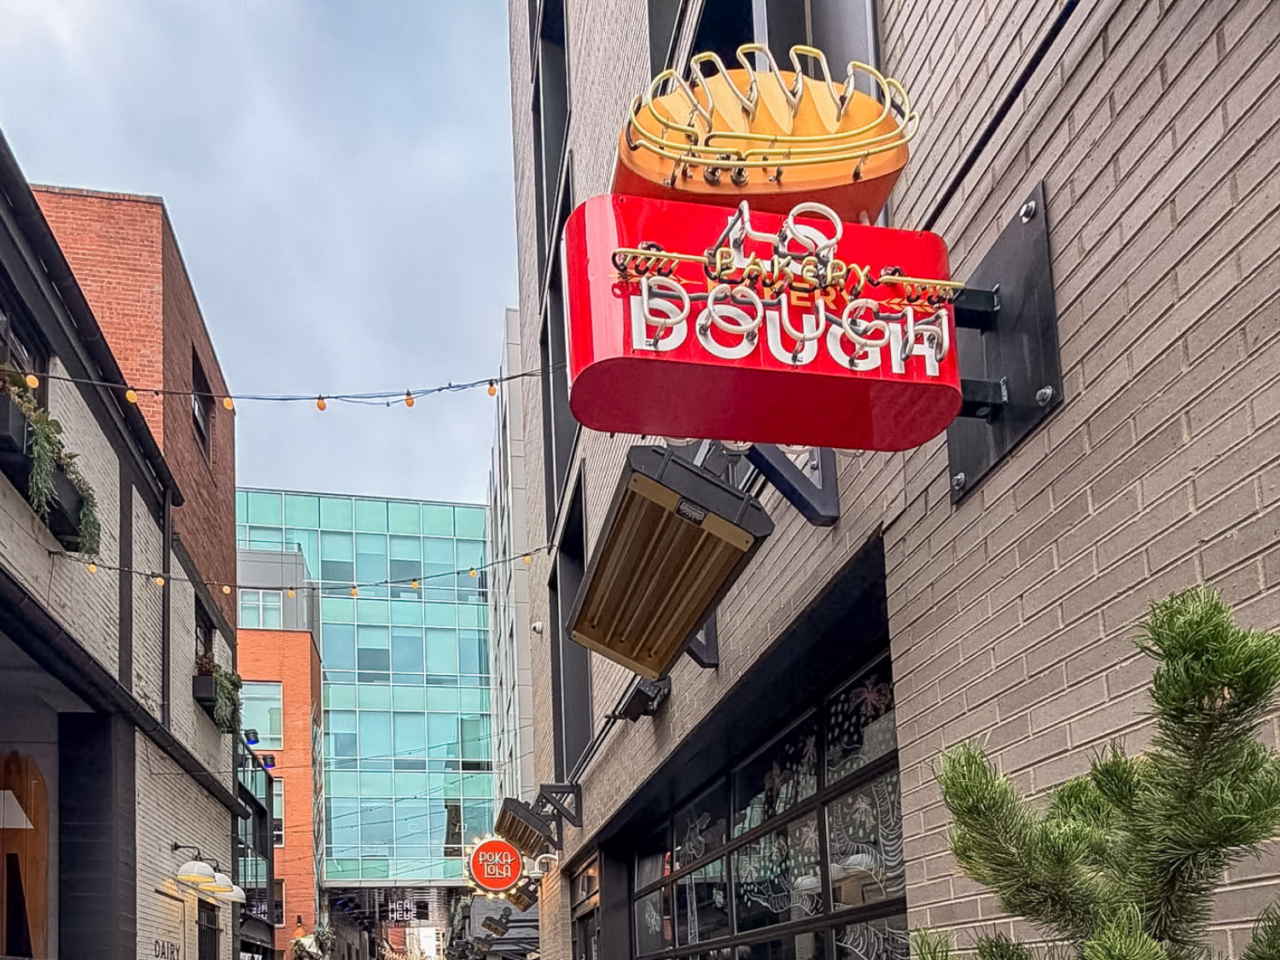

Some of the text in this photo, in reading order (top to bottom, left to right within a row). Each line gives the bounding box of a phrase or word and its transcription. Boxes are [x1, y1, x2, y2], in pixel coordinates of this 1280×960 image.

[712, 246, 872, 298] BAKERY
[630, 276, 949, 377] DOUGH
[479, 851, 516, 865] POKA
[484, 861, 511, 878] LOLA
[154, 940, 180, 960] DAIRY
